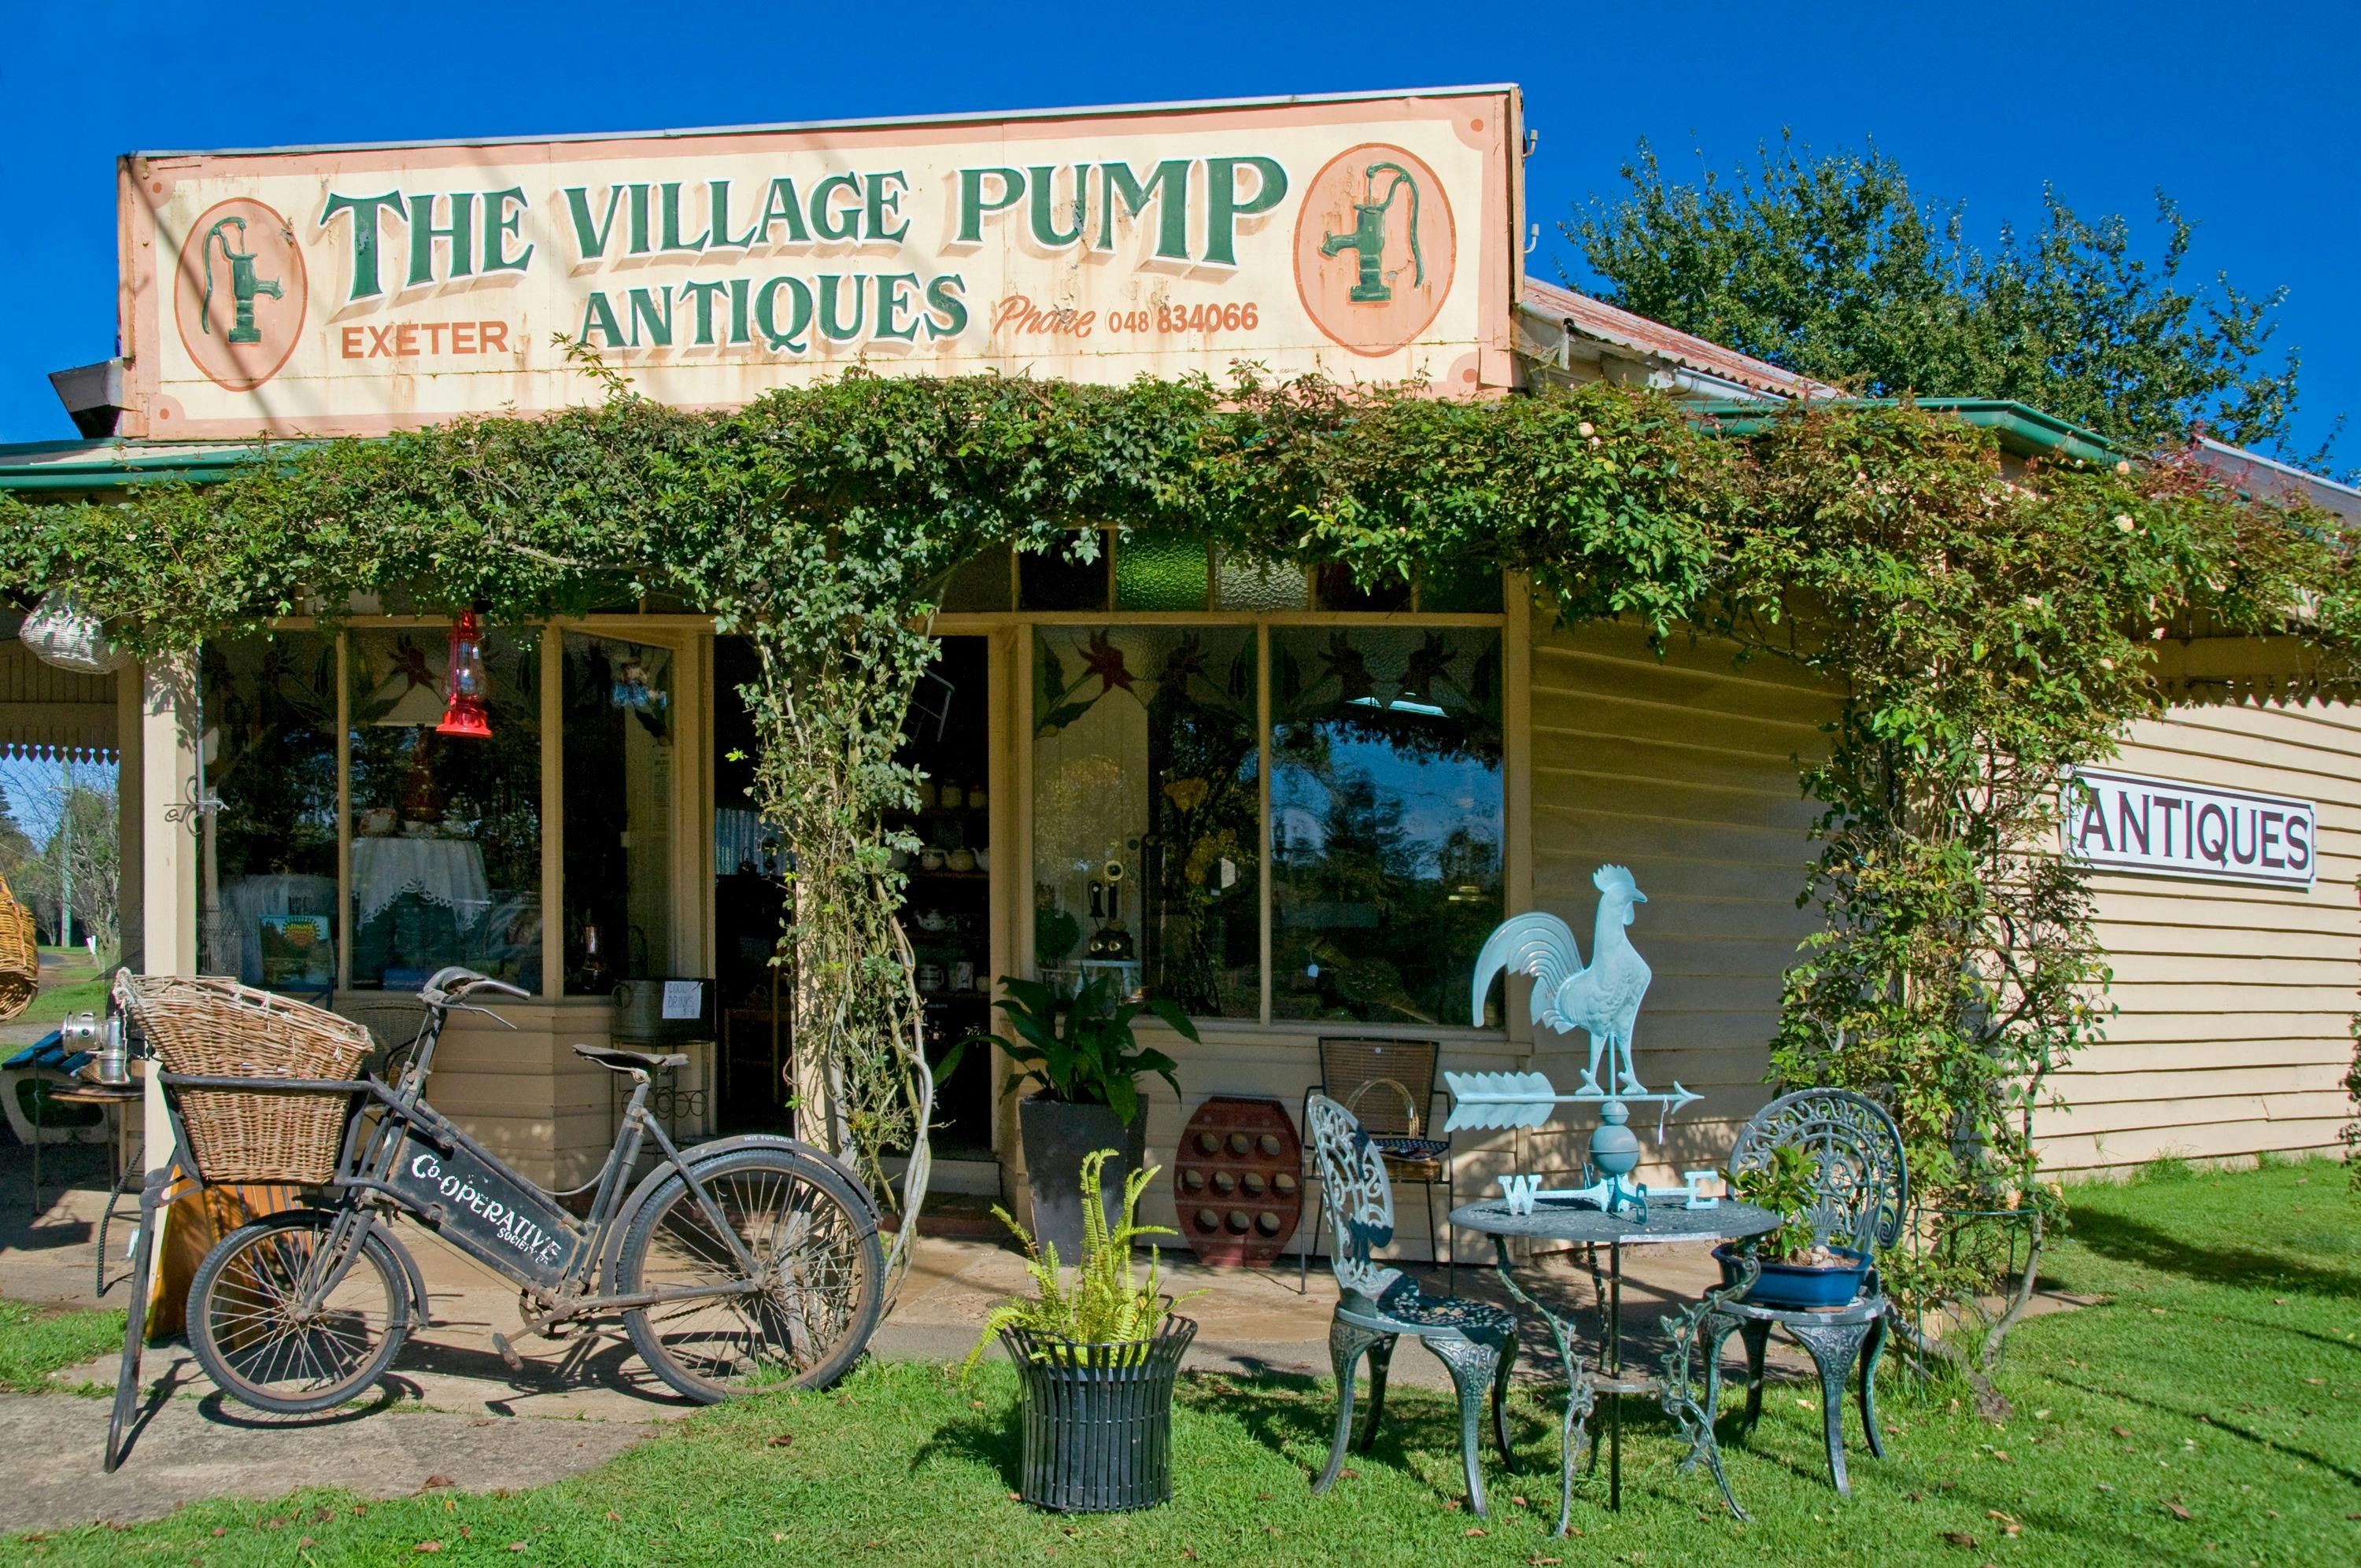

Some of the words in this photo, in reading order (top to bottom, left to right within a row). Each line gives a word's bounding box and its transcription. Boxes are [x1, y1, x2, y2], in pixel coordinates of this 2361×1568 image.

[319, 186, 537, 304] THE
[560, 169, 913, 261] VILLAGE
[955, 156, 1289, 266] PUMP
[578, 271, 970, 356] ANTIQUES
[992, 294, 1096, 339] Phone
[1156, 301, 1259, 334] 834066
[342, 320, 510, 359] EXETER
[2078, 787, 2310, 870] ANTIQUES
[667, 982, 687, 994] COOL
[1498, 1175, 1543, 1216] W
[1683, 1171, 1720, 1210] E
